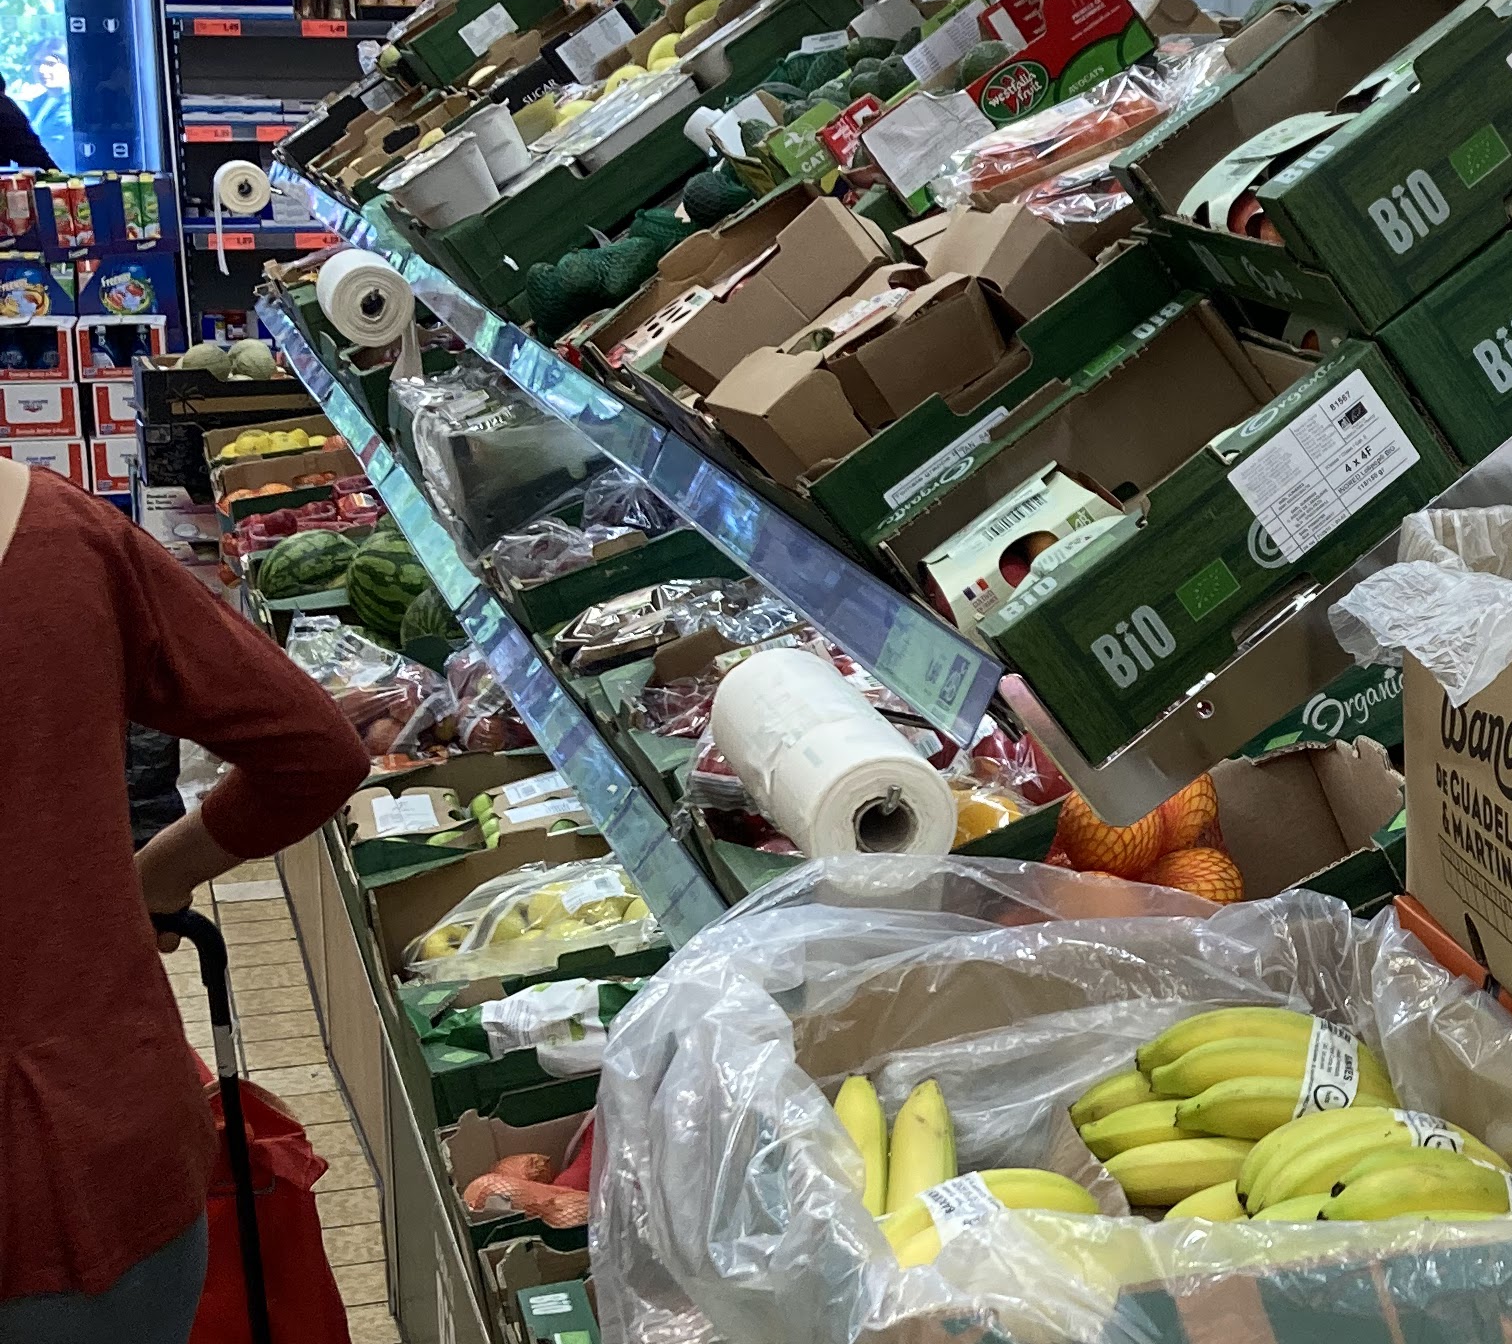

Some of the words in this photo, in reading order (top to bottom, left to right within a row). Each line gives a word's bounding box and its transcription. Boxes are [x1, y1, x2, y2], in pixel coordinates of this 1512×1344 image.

[987, 70, 1037, 106] westfalia
[1017, 82, 1043, 107] fruit
[1367, 168, 1451, 255] BiO
[1360, 445, 1374, 461] 4F
[1090, 604, 1177, 690] BiO
[1436, 761, 1449, 796] DE
